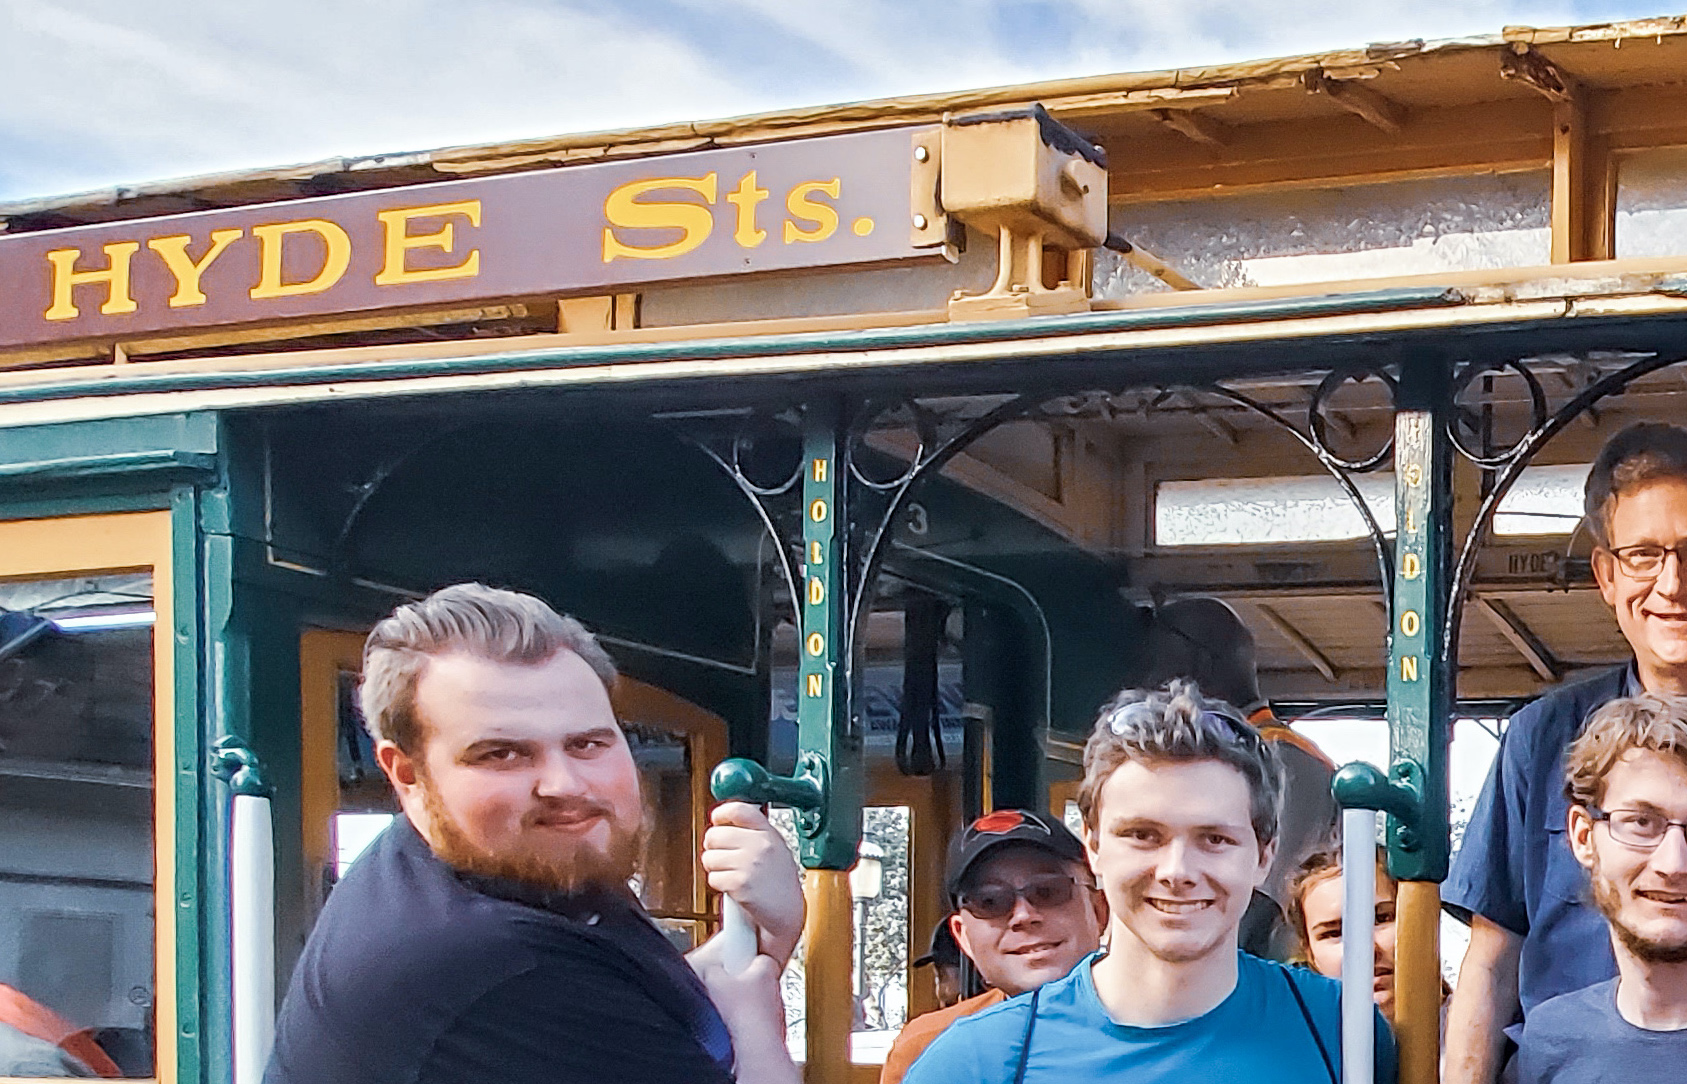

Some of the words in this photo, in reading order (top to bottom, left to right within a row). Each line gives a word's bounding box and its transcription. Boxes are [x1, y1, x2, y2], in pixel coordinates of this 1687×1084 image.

[45, 199, 482, 321] HYDE
[602, 169, 876, 264] Sts.
[807, 458, 829, 607] HOLD
[806, 631, 826, 699] ON
[1400, 609, 1421, 683] ON
